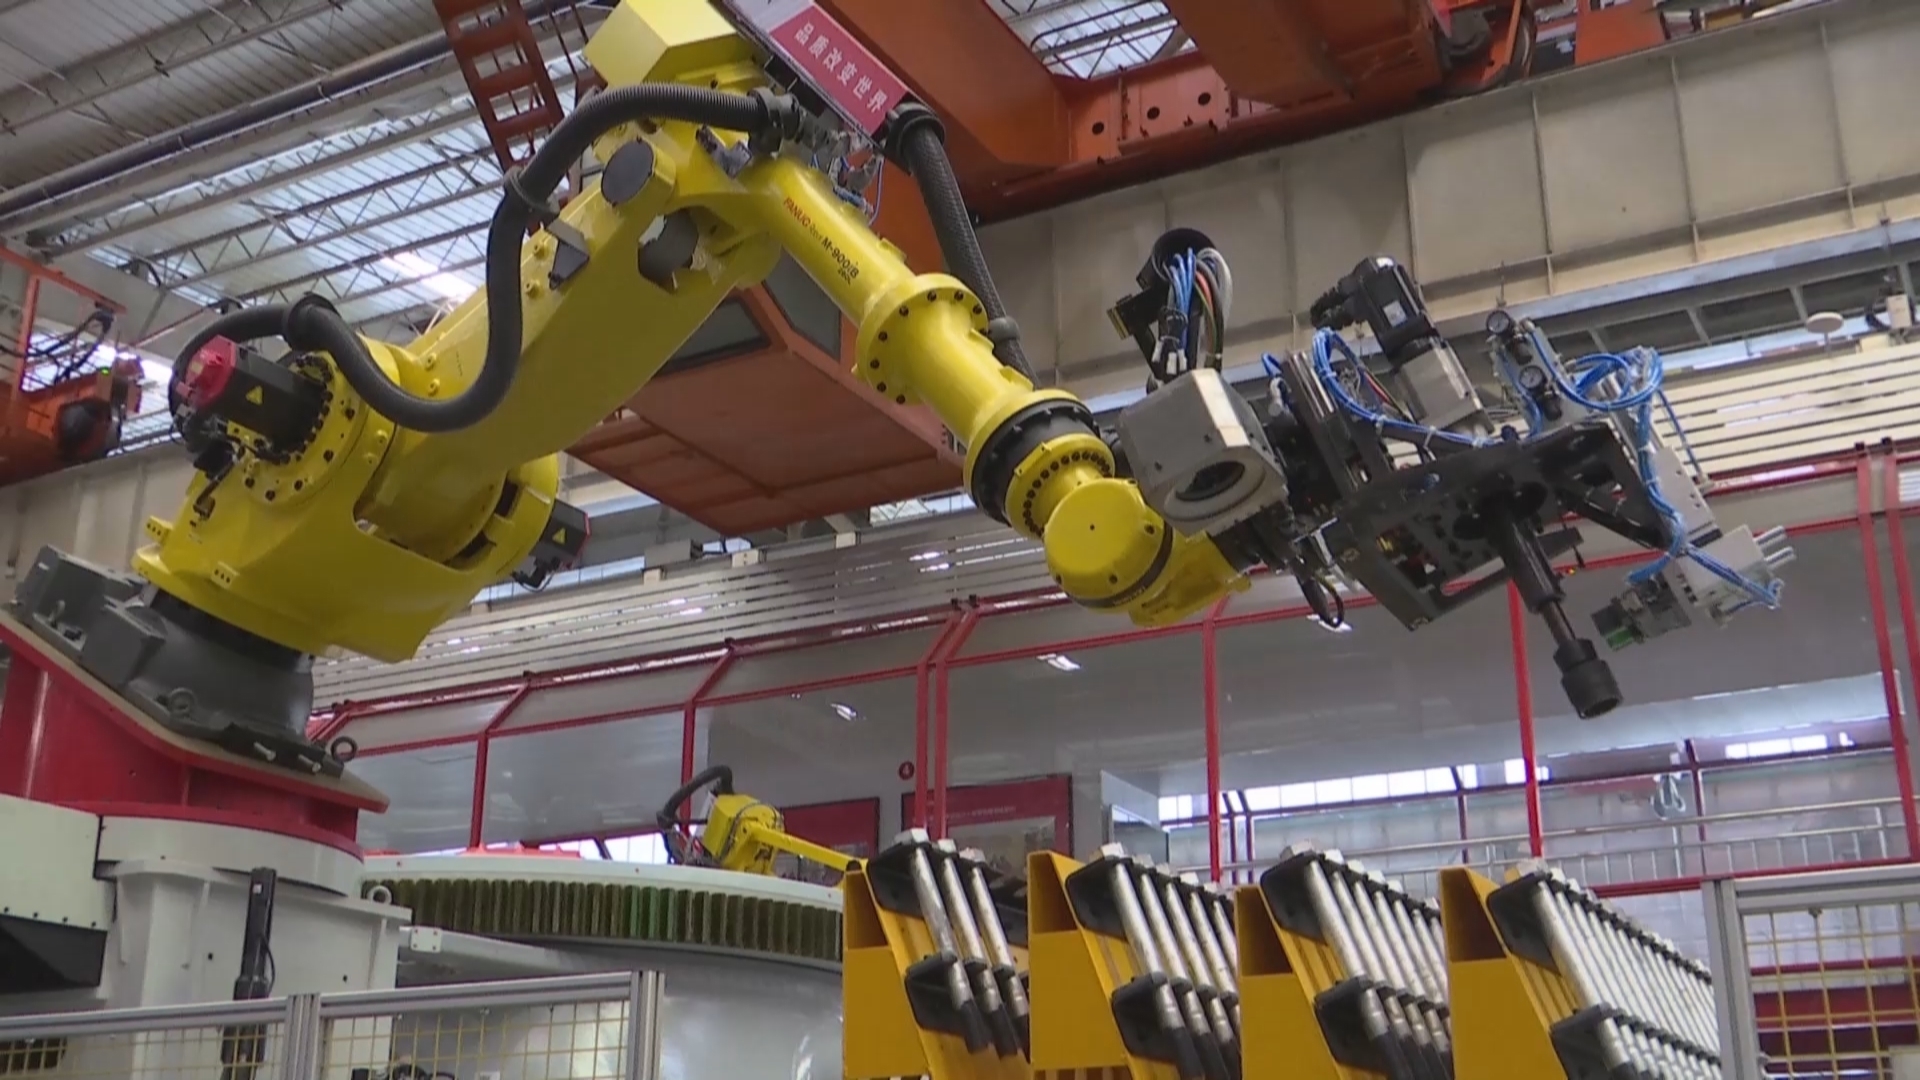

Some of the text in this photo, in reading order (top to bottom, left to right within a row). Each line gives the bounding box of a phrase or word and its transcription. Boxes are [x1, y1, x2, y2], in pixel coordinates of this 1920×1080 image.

[794, 22, 888, 113] 品质改变世界
[784, 197, 811, 227] FANUC
